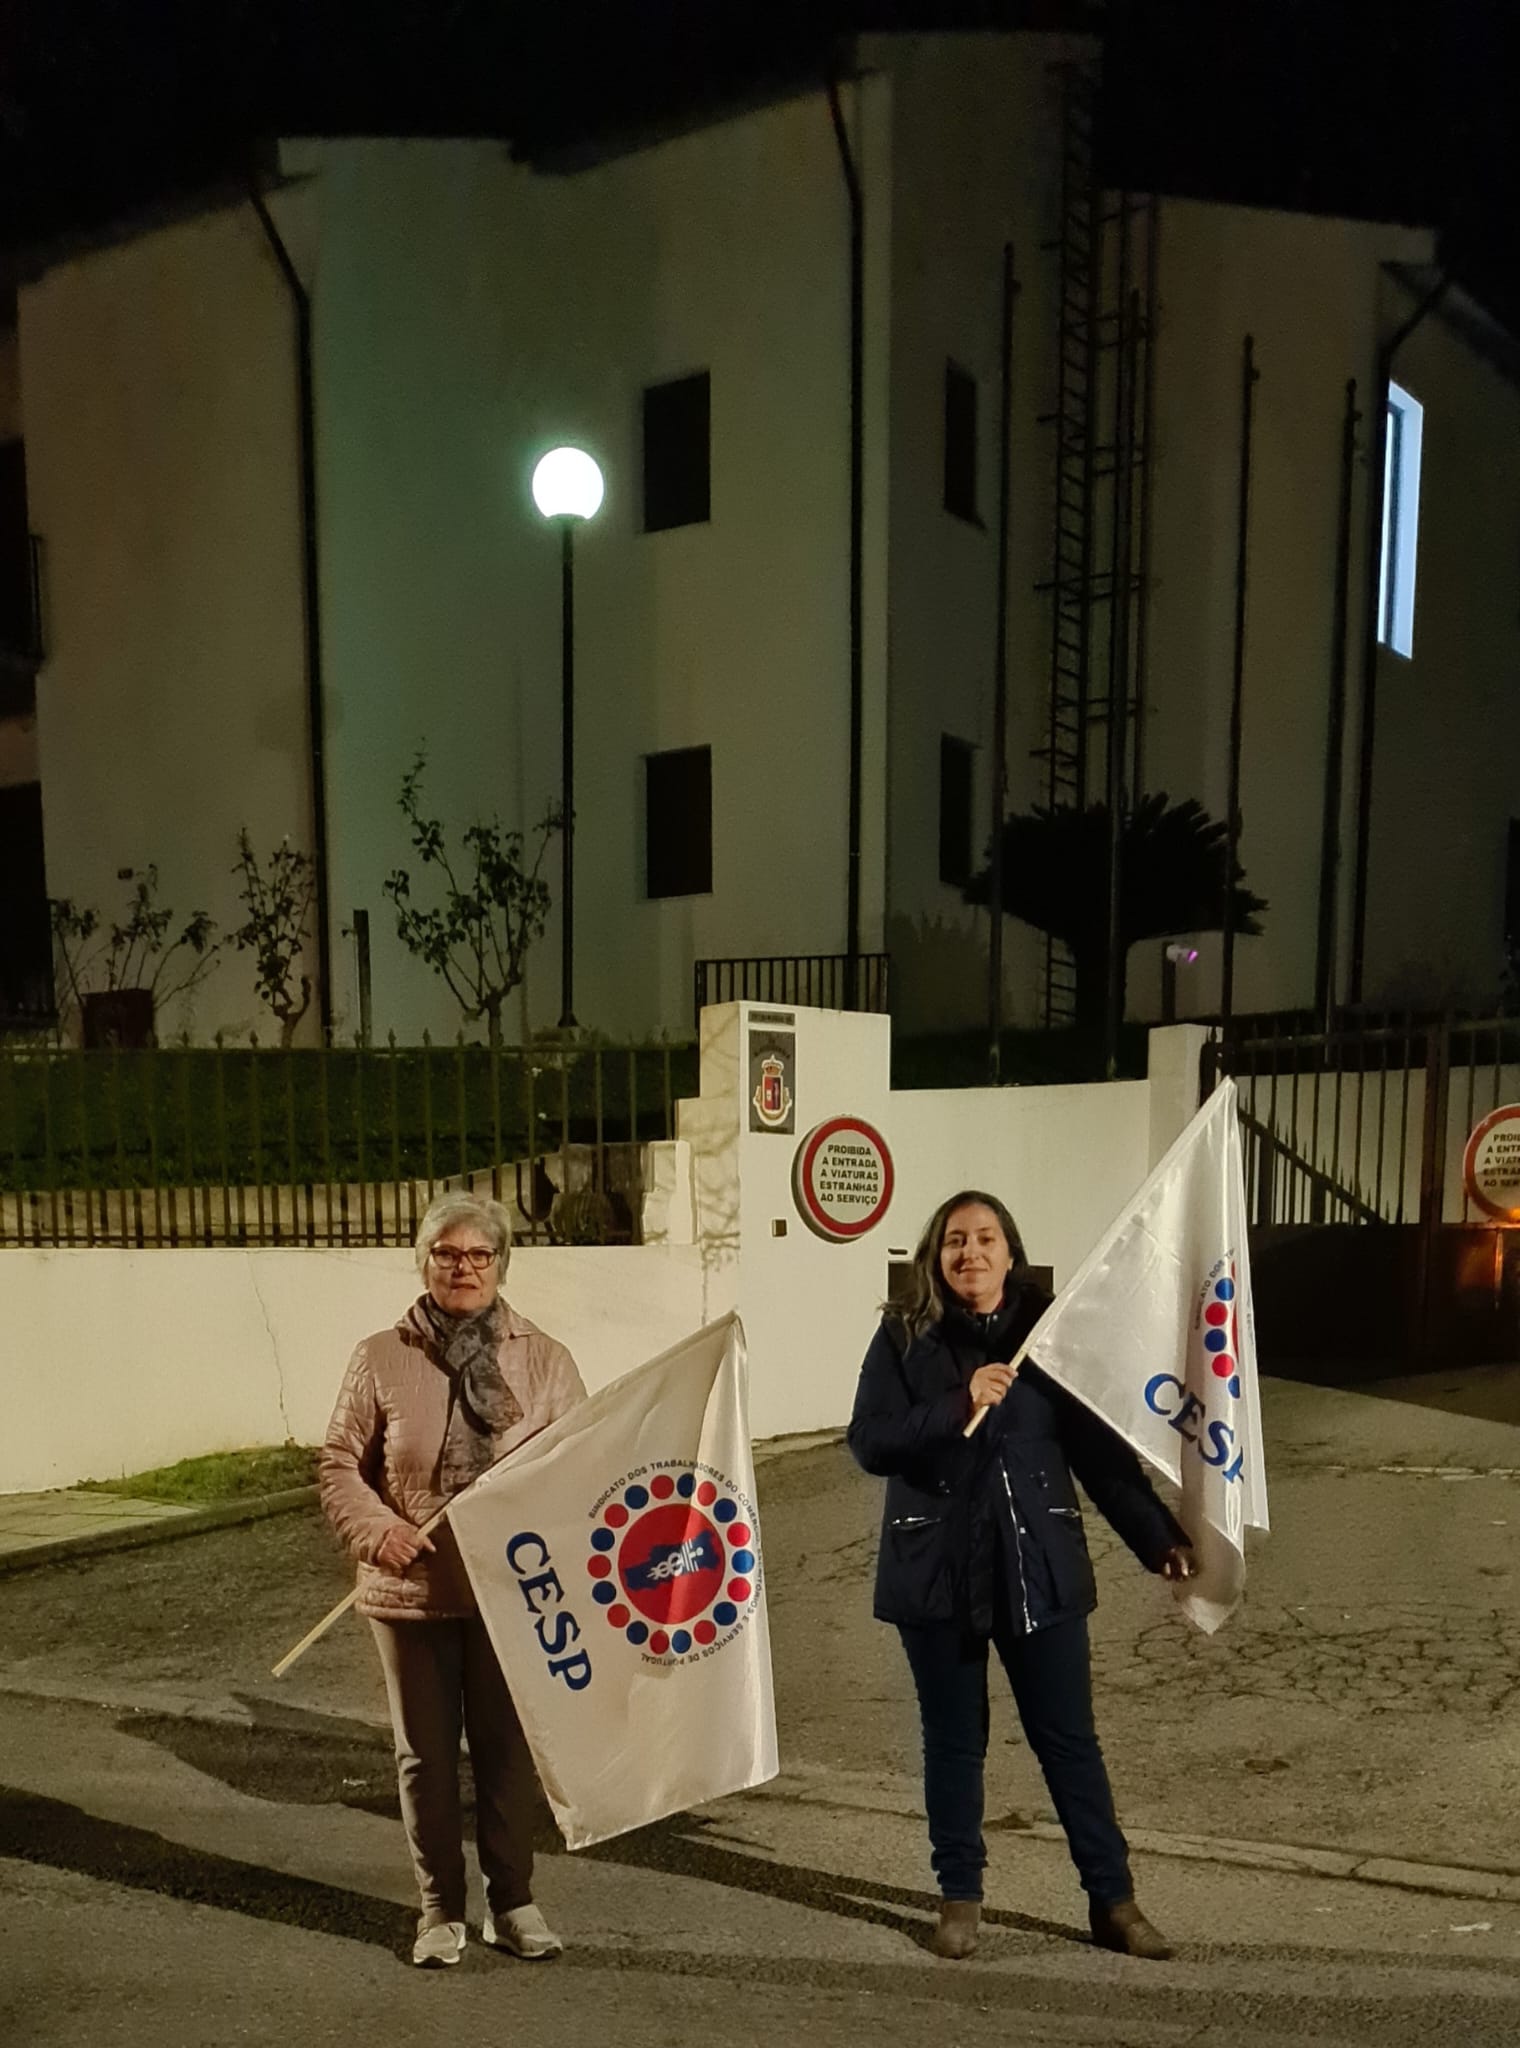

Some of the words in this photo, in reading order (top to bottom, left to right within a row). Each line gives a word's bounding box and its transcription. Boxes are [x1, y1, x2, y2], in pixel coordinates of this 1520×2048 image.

[828, 1144, 871, 1155] PROIBIDA
[1487, 1145, 1494, 1153] A
[822, 1156, 829, 1165] A
[832, 1157, 877, 1168] ENTRADA
[1484, 1156, 1491, 1164] A
[821, 1168, 828, 1177] A
[831, 1169, 879, 1180] VIATURAS
[820, 1181, 878, 1192] ESTRANHAS
[821, 1193, 834, 1202] AO
[837, 1194, 878, 1205] SERVIÇO
[627, 1466, 648, 1480] DOS
[725, 1480, 738, 1493] DO
[588, 1478, 626, 1519] SINDICATO
[506, 1531, 592, 1691] CESP
[702, 1622, 744, 1657] SERVIÇOS
[688, 1653, 700, 1661] DE
